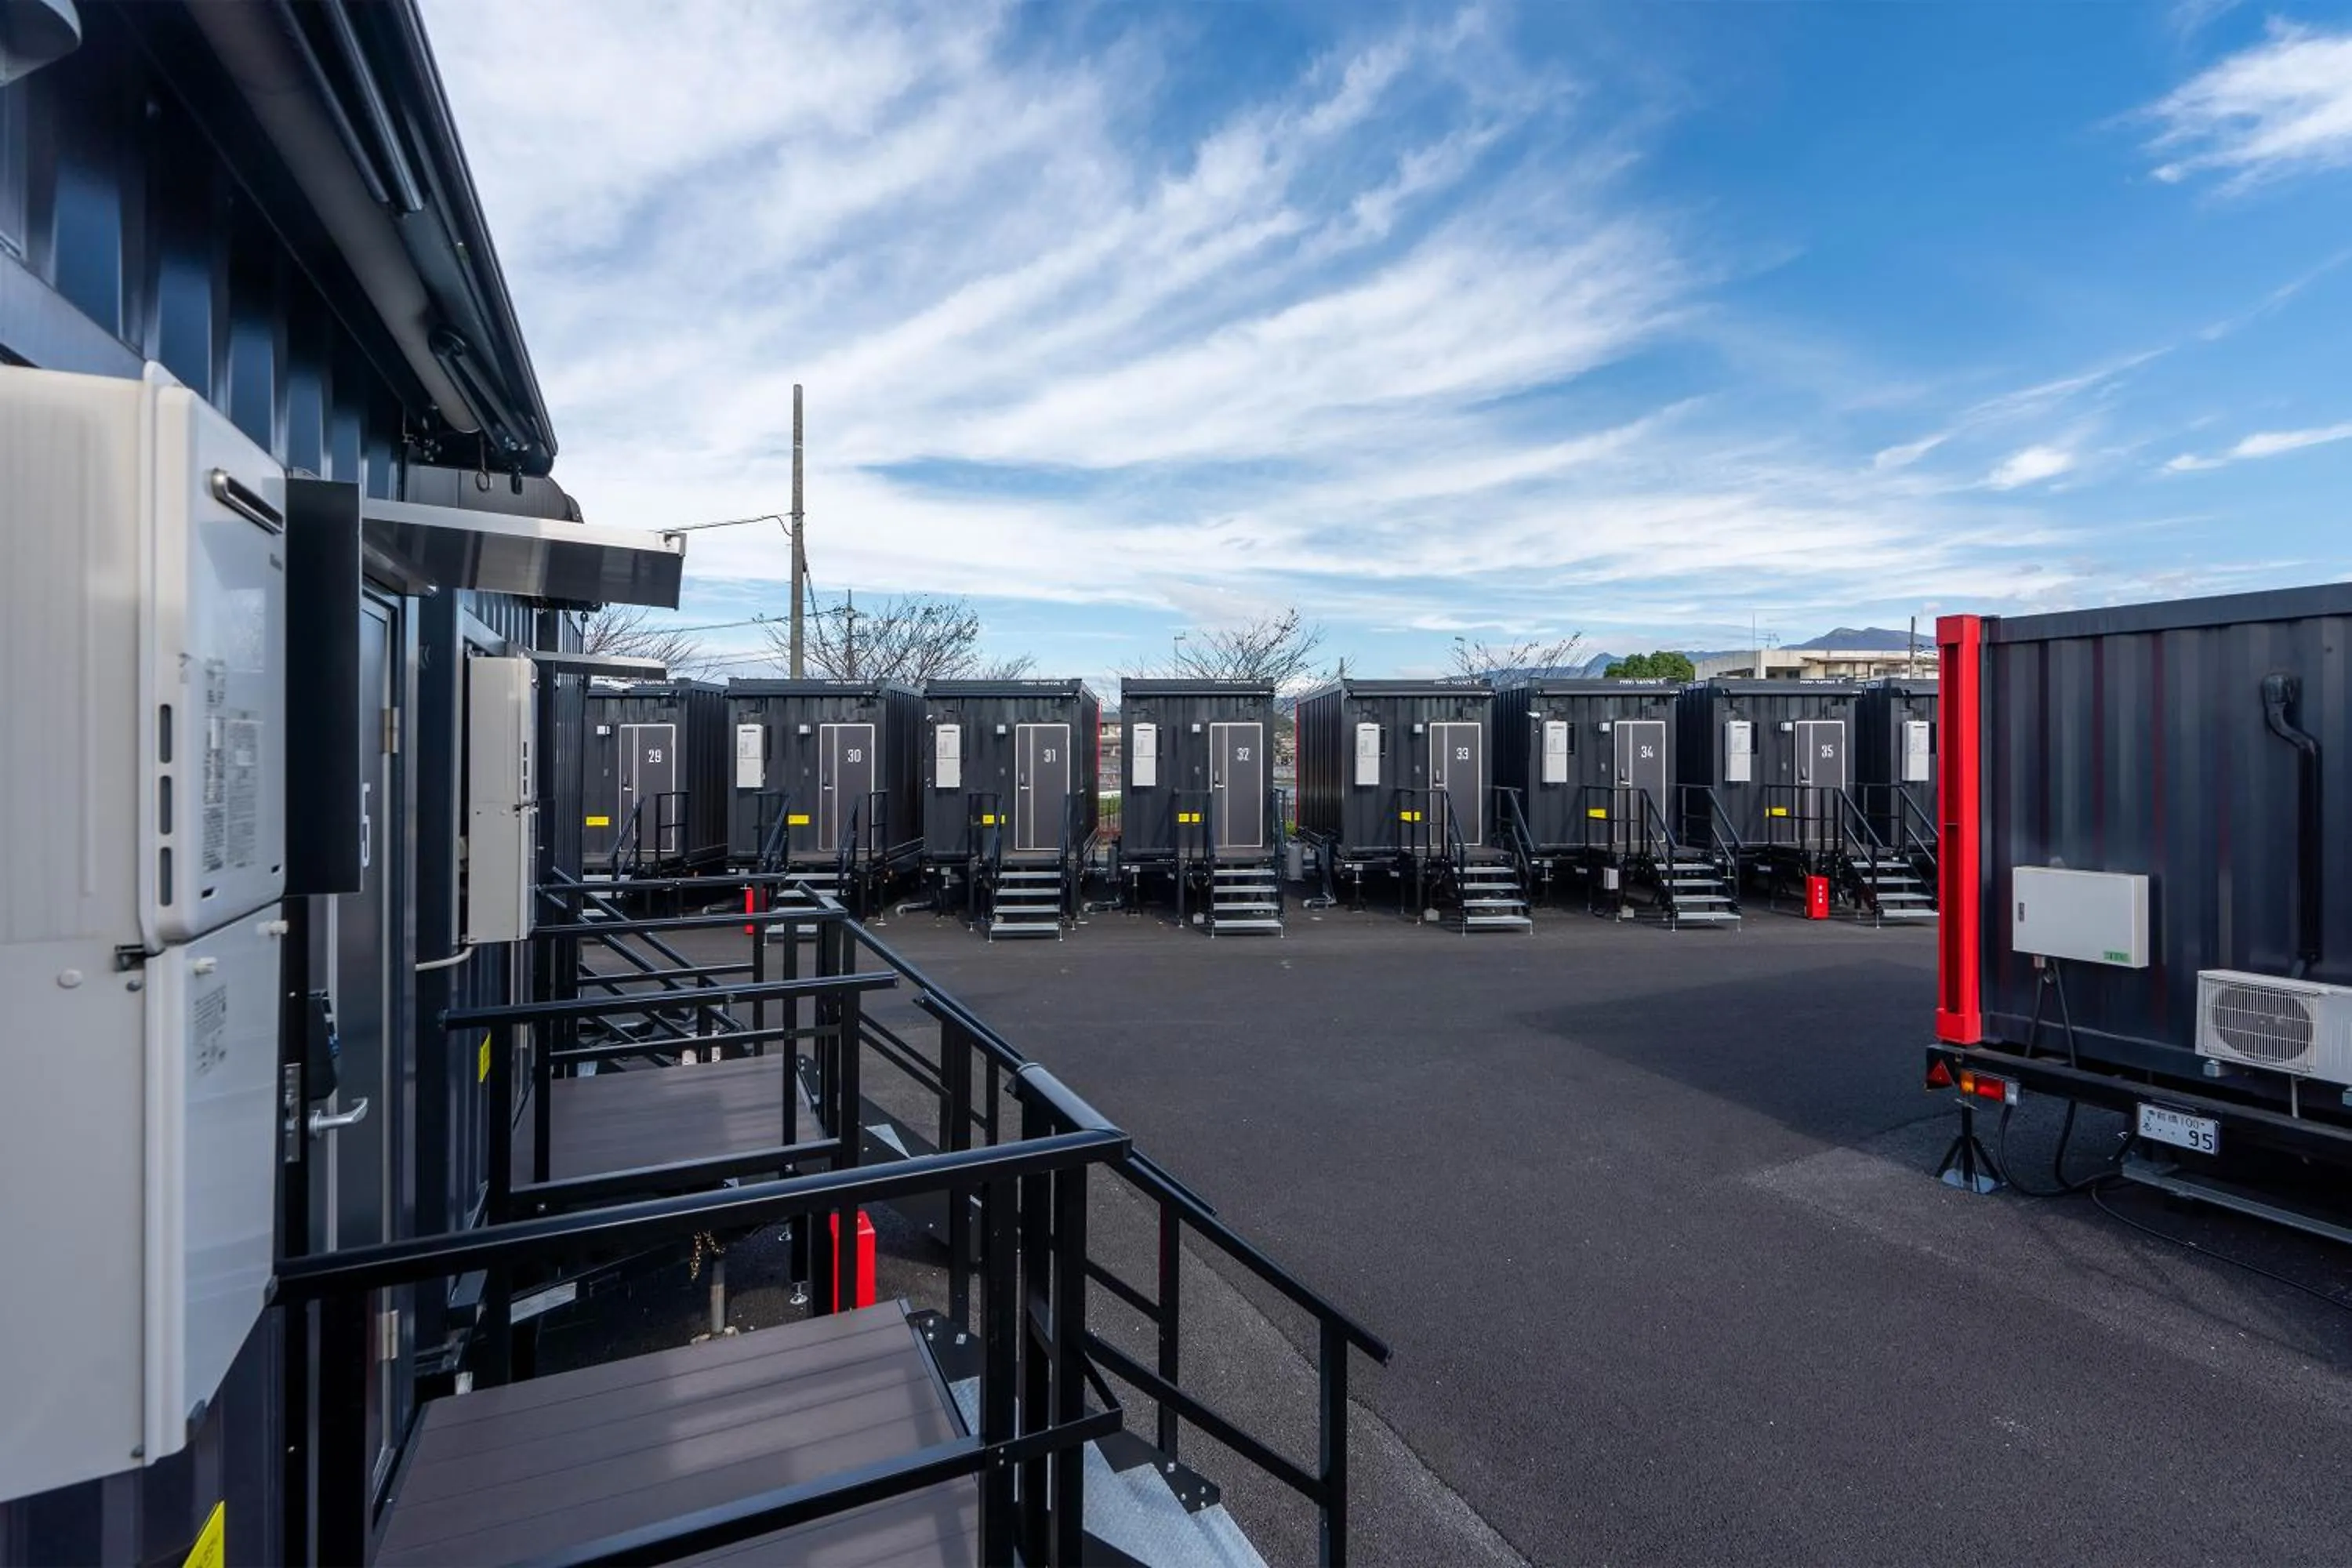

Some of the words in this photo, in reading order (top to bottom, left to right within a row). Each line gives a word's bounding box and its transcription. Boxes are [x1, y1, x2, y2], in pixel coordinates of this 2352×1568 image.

[648, 749, 662, 763] 29
[848, 749, 862, 763] 30
[1044, 749, 1056, 763] 31
[1236, 747, 1250, 761] 32
[1456, 747, 1468, 760] 33
[1640, 746, 1654, 758] 34
[1820, 744, 1834, 758] 35
